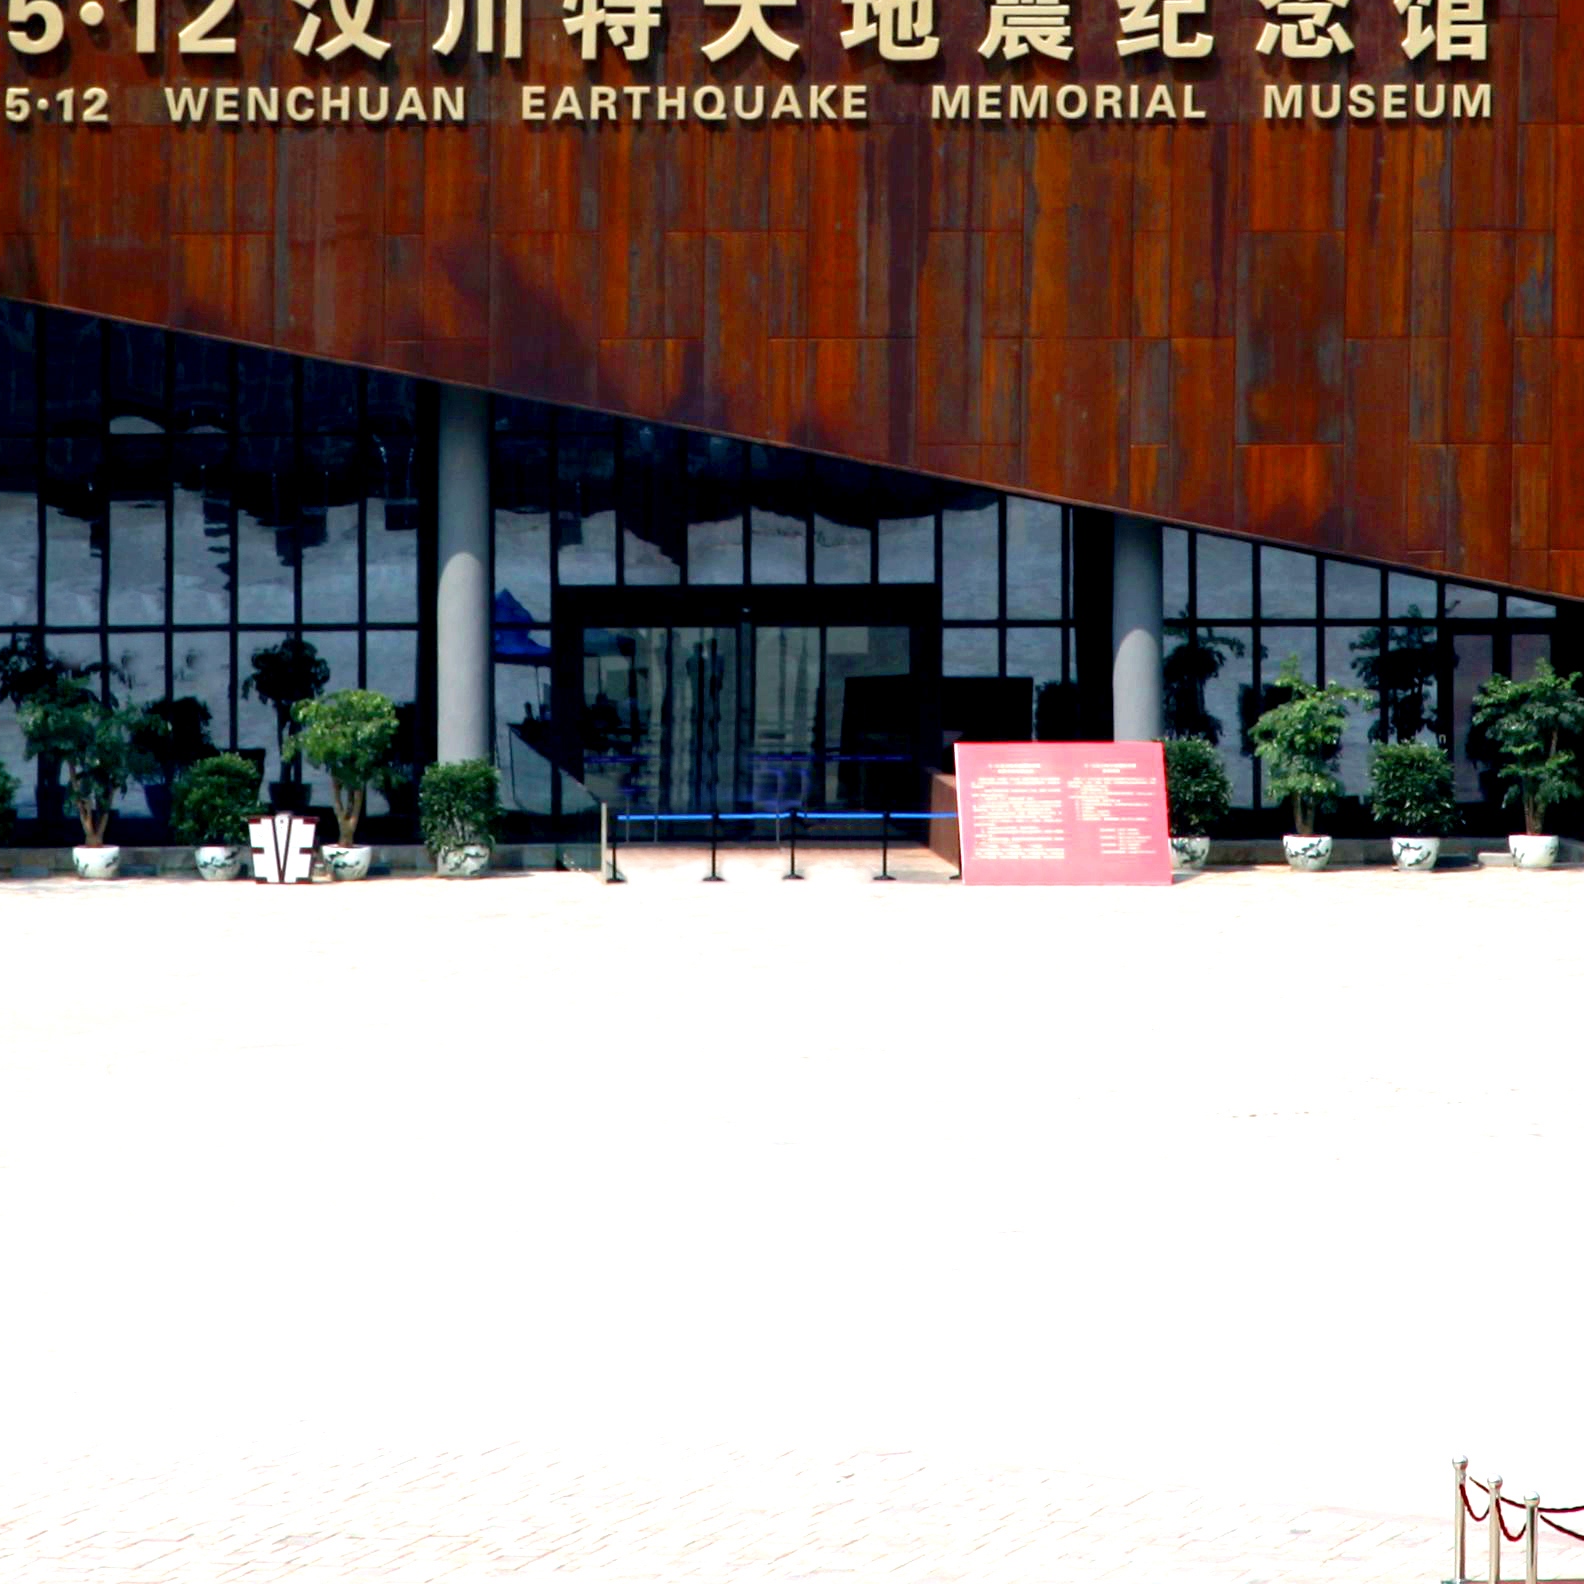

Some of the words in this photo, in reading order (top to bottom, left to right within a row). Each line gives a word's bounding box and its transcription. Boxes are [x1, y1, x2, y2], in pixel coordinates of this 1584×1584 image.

[164, 85, 465, 122] WENCHUAN
[521, 84, 868, 121] EARTHQUAKE
[931, 83, 1206, 120] MEMORIAL
[1262, 83, 1492, 119] MUSEUM
